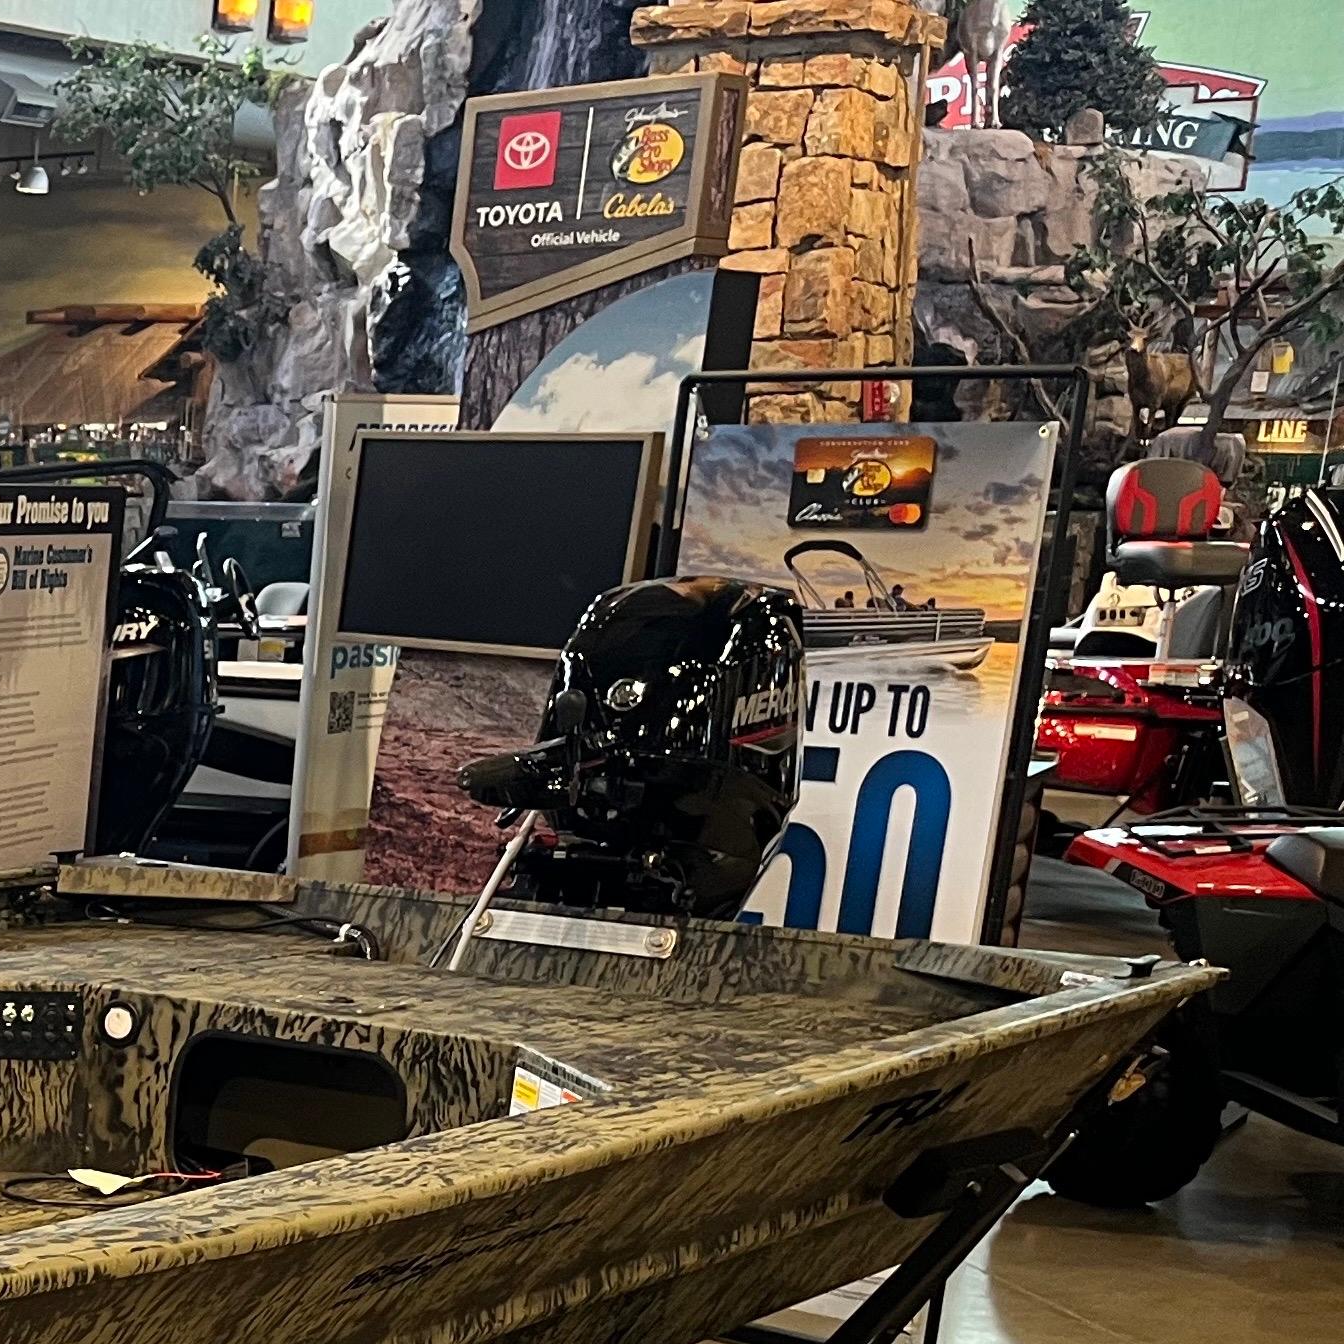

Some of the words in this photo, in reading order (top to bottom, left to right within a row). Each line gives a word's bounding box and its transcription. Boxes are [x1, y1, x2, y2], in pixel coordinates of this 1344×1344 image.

[642, 128, 670, 144] Bass
[638, 158, 673, 175] Shops
[477, 201, 563, 227] TOYOTA
[604, 192, 675, 219] Cabela's
[530, 230, 574, 248] Official
[575, 228, 621, 246] Vehicle
[1257, 420, 1308, 443] LINE
[16, 494, 69, 525] Promise
[71, 496, 85, 524] to
[86, 501, 110, 530] you
[828, 681, 876, 735] UP
[888, 684, 931, 739] TO
